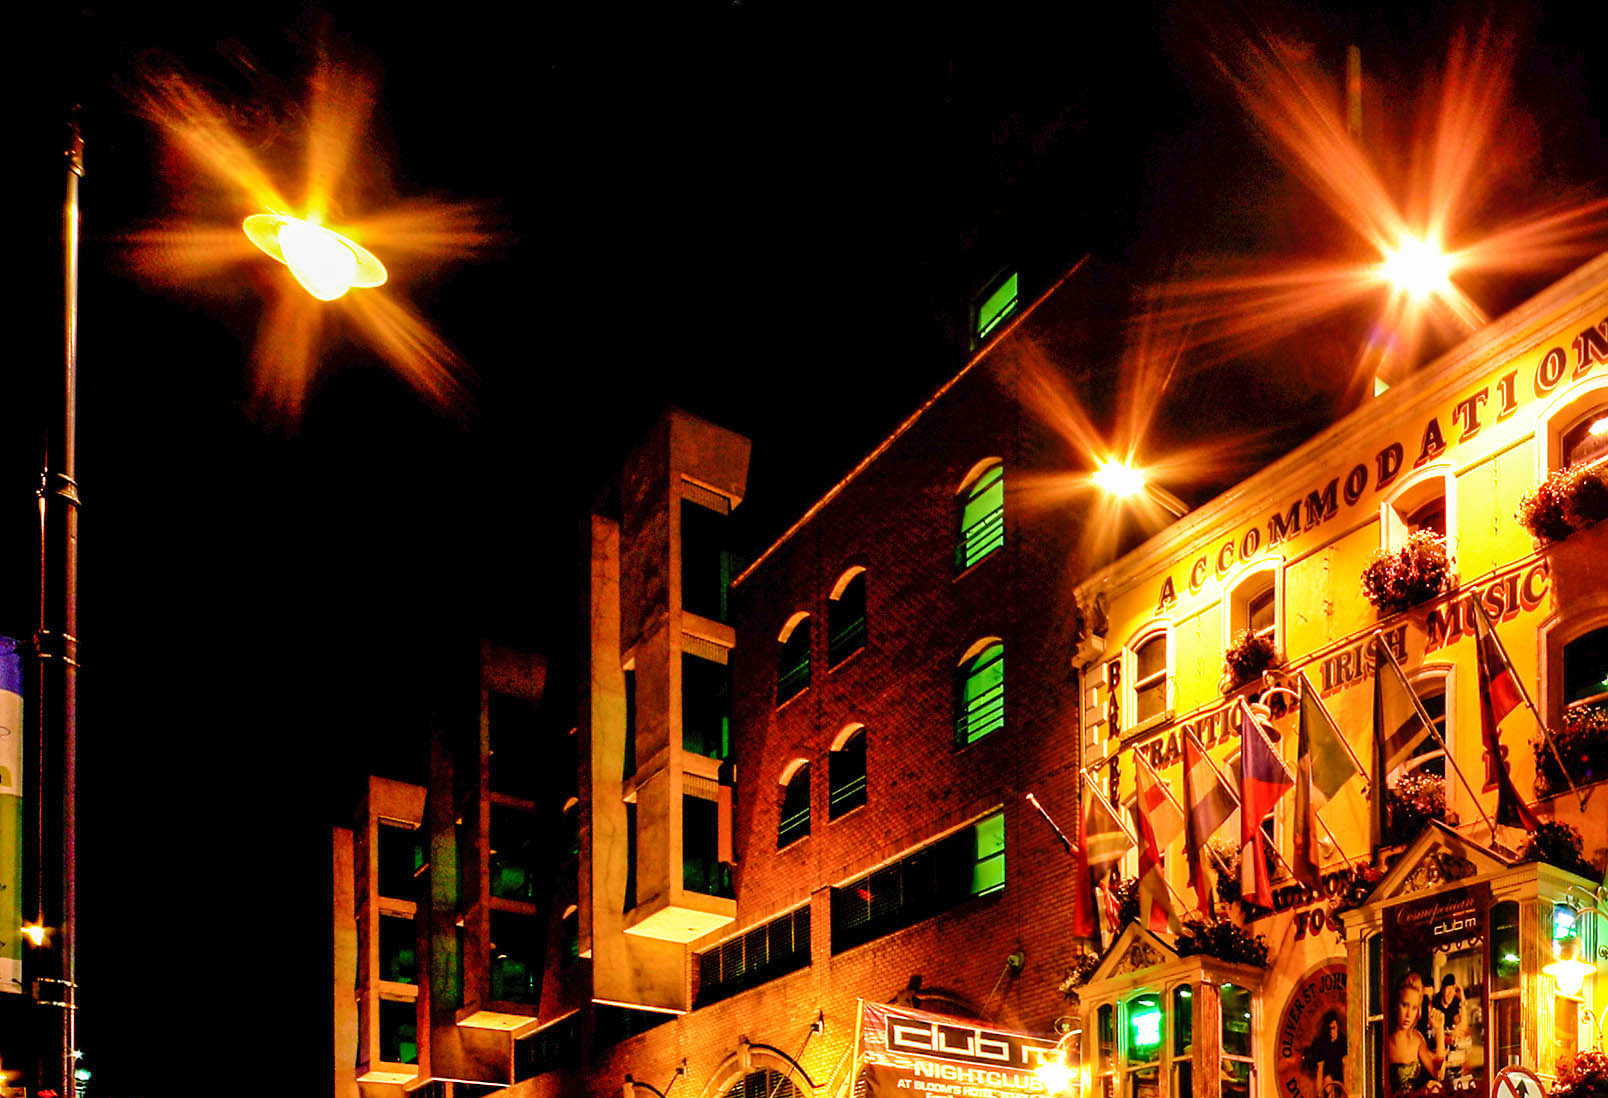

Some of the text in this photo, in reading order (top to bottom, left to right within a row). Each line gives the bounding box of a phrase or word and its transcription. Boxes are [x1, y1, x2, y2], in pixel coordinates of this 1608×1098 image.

[1319, 624, 1408, 699] IRISH
[1424, 565, 1550, 656] MUSIC
[892, 1023, 1010, 1062] club
[1282, 999, 1306, 1059] OLIVER
[897, 1079, 912, 1089] AT
[914, 1061, 1046, 1092] NIGHTCLUB
